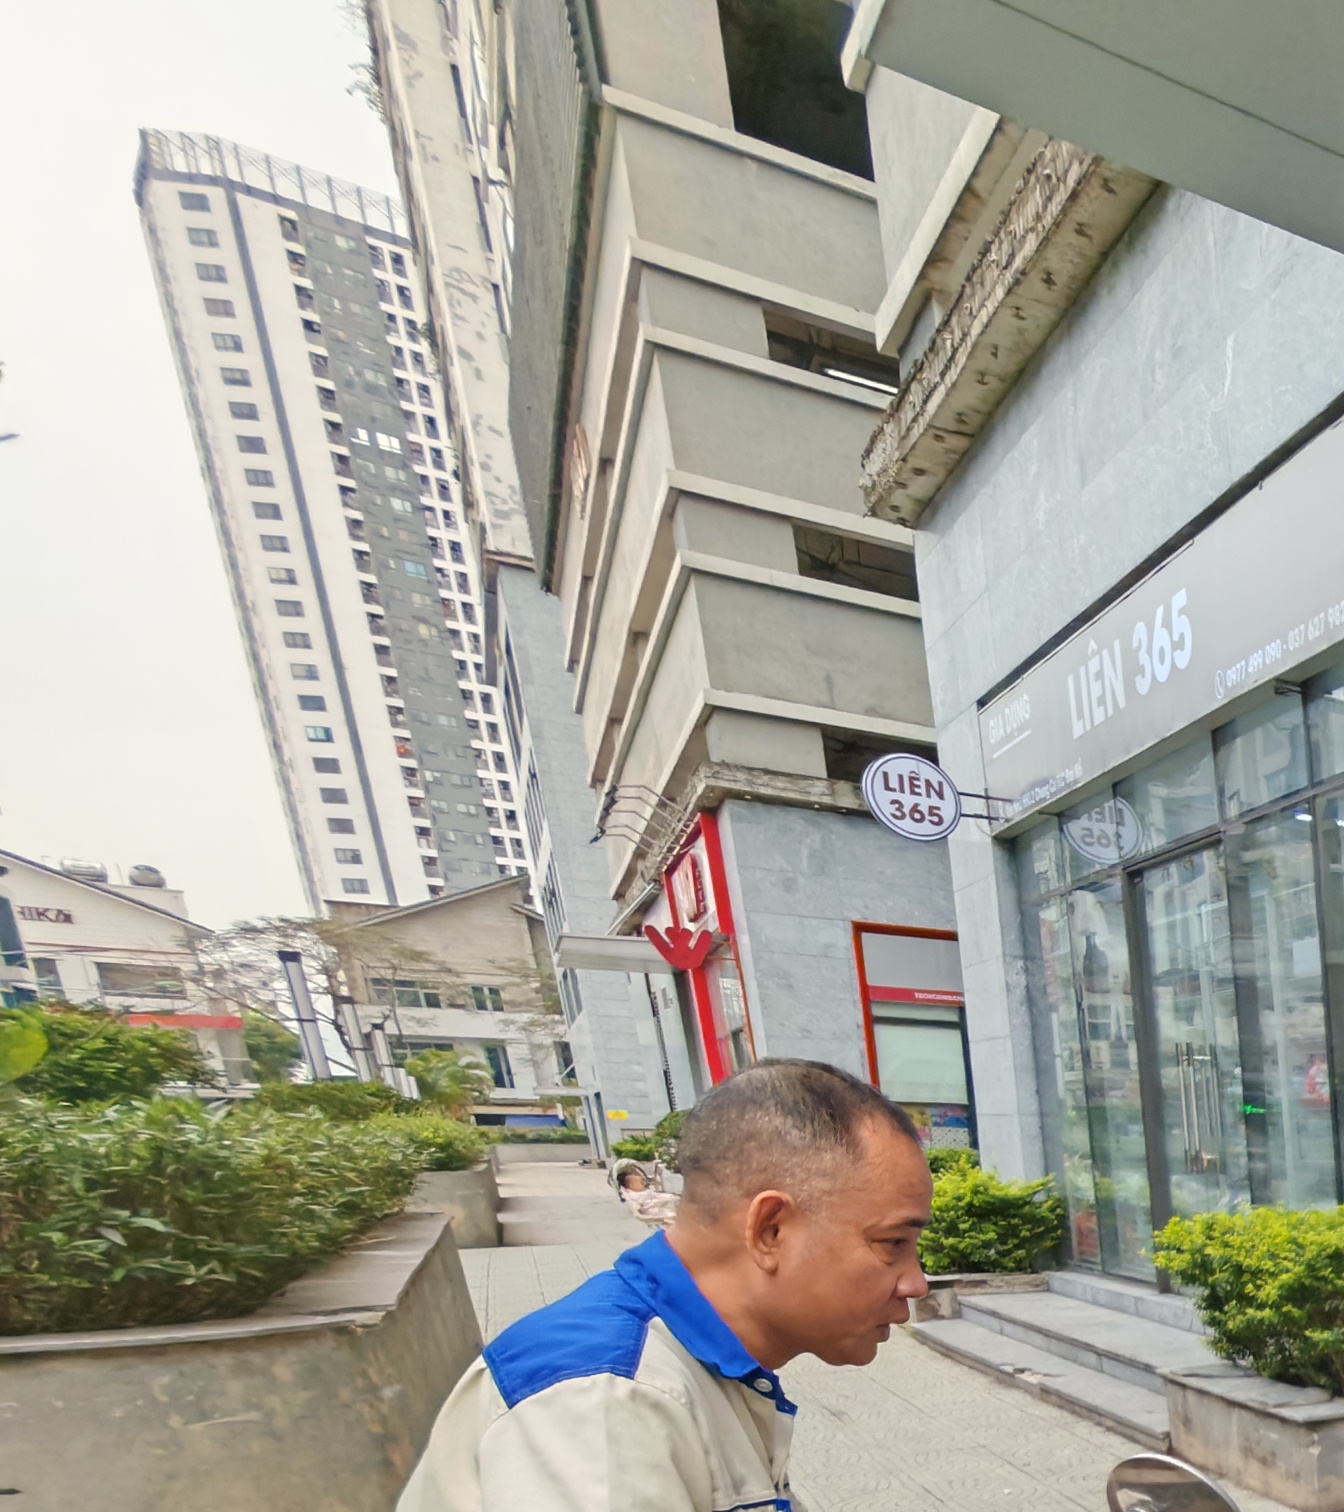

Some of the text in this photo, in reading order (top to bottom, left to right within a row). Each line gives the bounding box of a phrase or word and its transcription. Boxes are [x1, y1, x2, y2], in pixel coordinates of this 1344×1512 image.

[1067, 587, 1192, 739] LIÊN 365
[988, 692, 1030, 745] GIA DỤNG
[882, 771, 945, 801] LIÊN
[889, 799, 944, 827] 365
